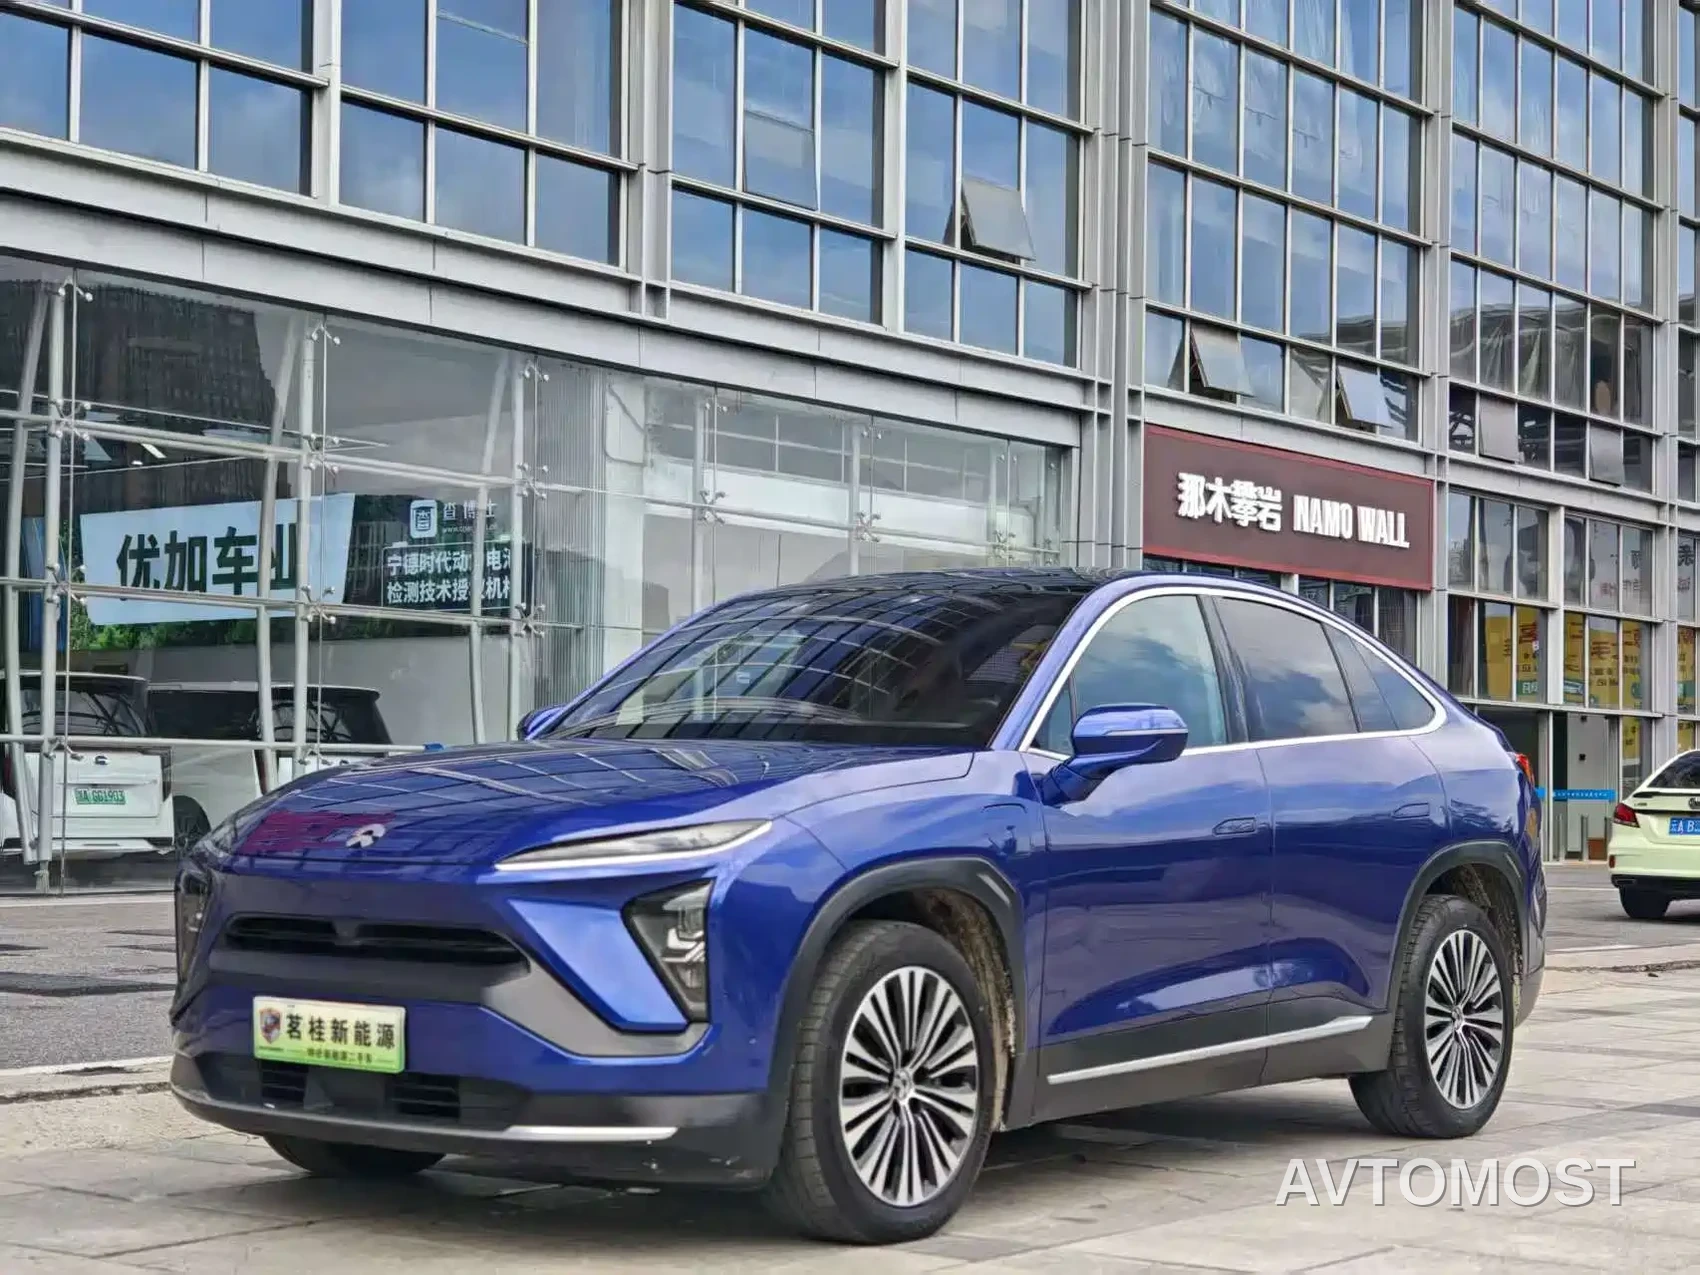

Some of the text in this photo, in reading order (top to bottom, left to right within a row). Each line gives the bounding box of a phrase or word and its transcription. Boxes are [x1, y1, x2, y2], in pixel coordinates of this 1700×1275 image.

[1177, 472, 1282, 532] 那木攀岩
[1293, 494, 1410, 548] NAMO WALL
[116, 523, 297, 596] 优加车业
[387, 547, 511, 576] 宁德时代动电
[387, 575, 511, 604] 检测技术授机
[286, 1013, 395, 1049] 茗桂新能源
